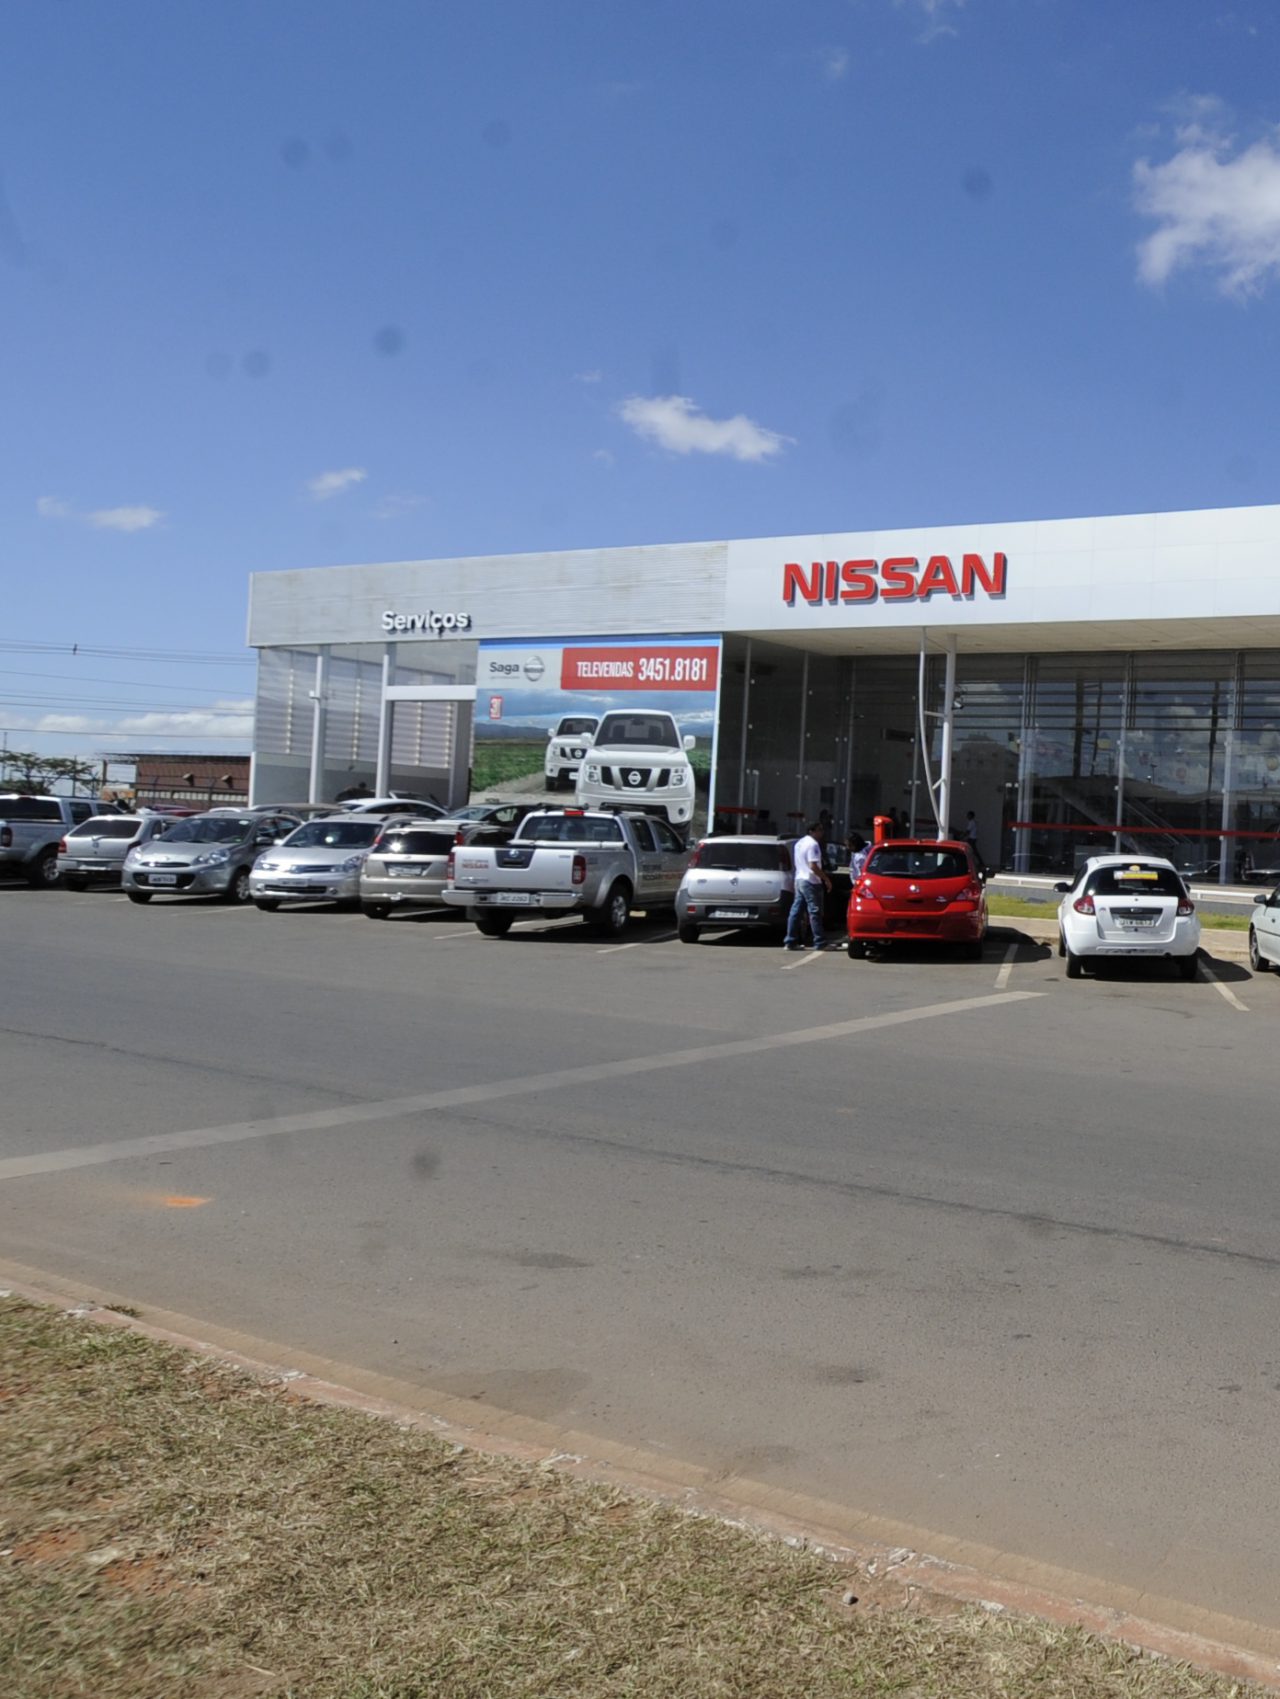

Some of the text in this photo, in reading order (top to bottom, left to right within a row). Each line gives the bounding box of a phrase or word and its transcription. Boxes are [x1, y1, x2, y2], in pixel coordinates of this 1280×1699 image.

[782, 552, 1007, 607] NISSAN
[381, 609, 472, 637] Serviços
[489, 661, 520, 675] Saga
[576, 656, 708, 682] TELEVENDAS 3451.8181
